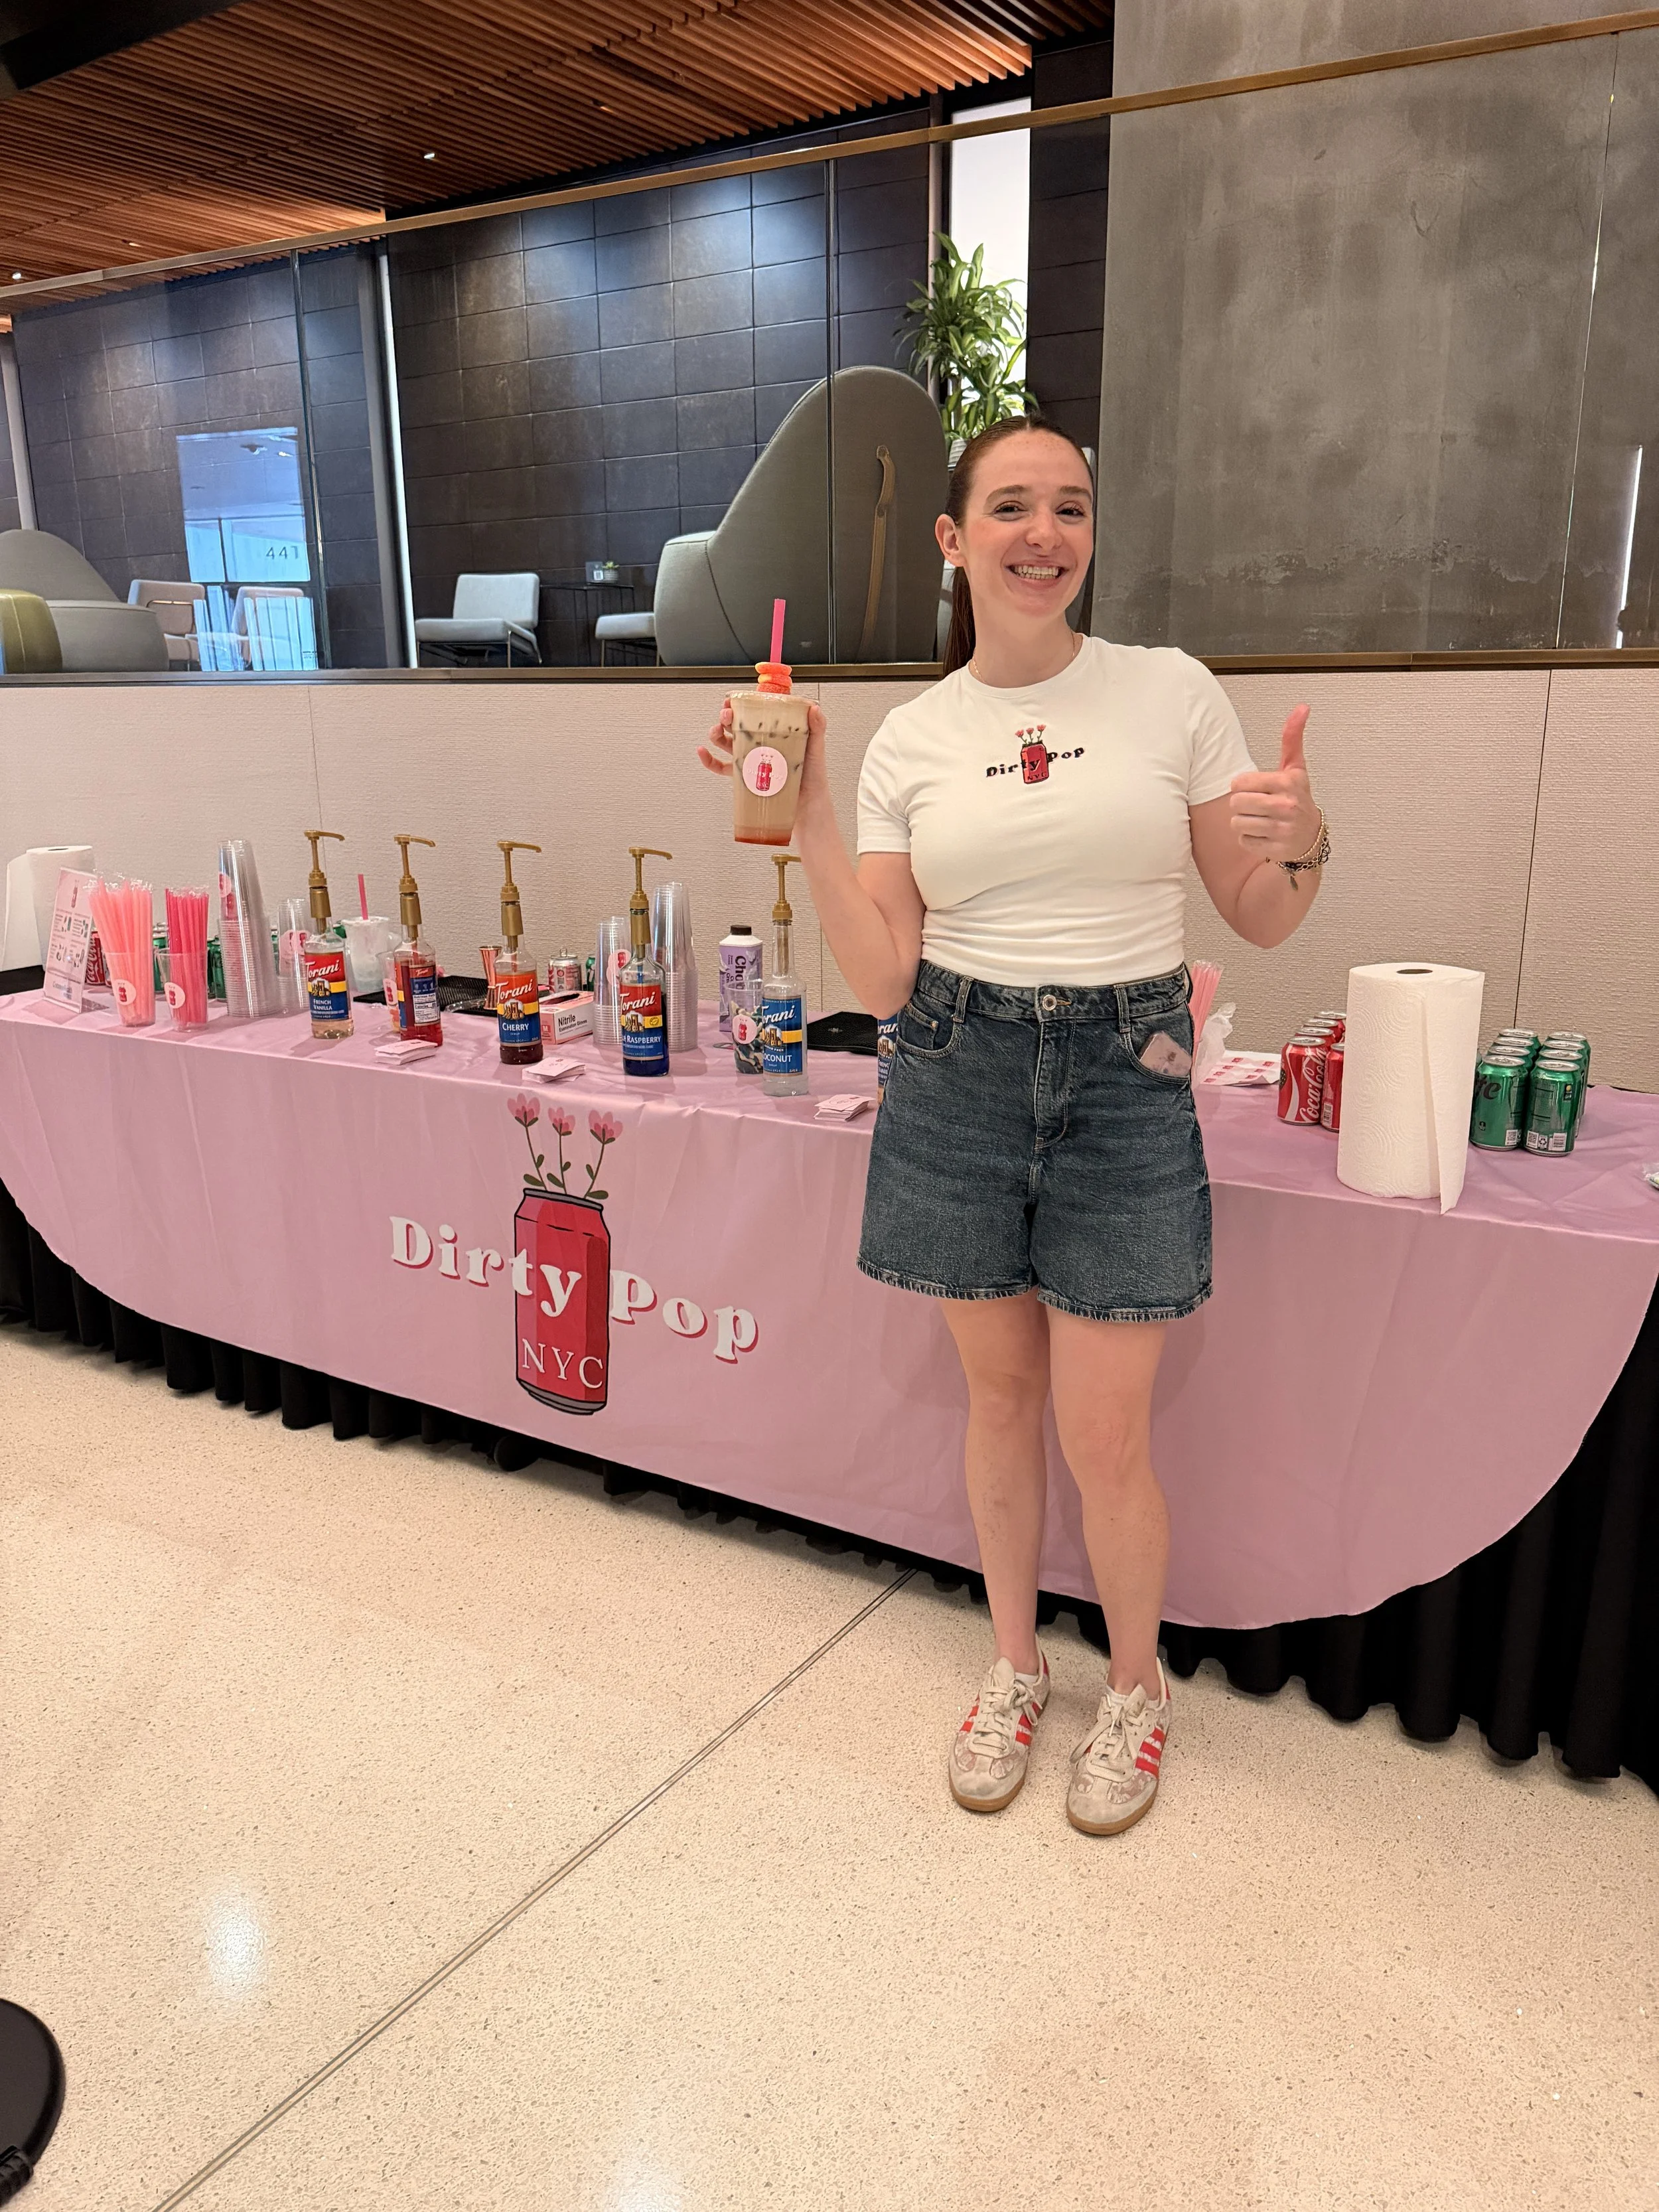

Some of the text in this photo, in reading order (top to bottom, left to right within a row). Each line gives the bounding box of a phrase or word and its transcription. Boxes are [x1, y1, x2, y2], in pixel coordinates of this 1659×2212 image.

[985, 747, 1085, 778] Dirty Pop
[1027, 771, 1047, 781] NYC
[305, 960, 340, 981] Torani
[735, 956, 747, 990] Chob
[495, 979, 533, 1004] Torani
[620, 992, 656, 1013] Torani
[558, 1014, 575, 1027] Nitrile
[761, 1005, 795, 1024] Torani
[502, 1023, 529, 1031] CHERRY
[626, 1035, 662, 1044] RASPBERRY
[389, 1216, 759, 1364] Dirty Pop
[521, 1339, 605, 1390] NYC
